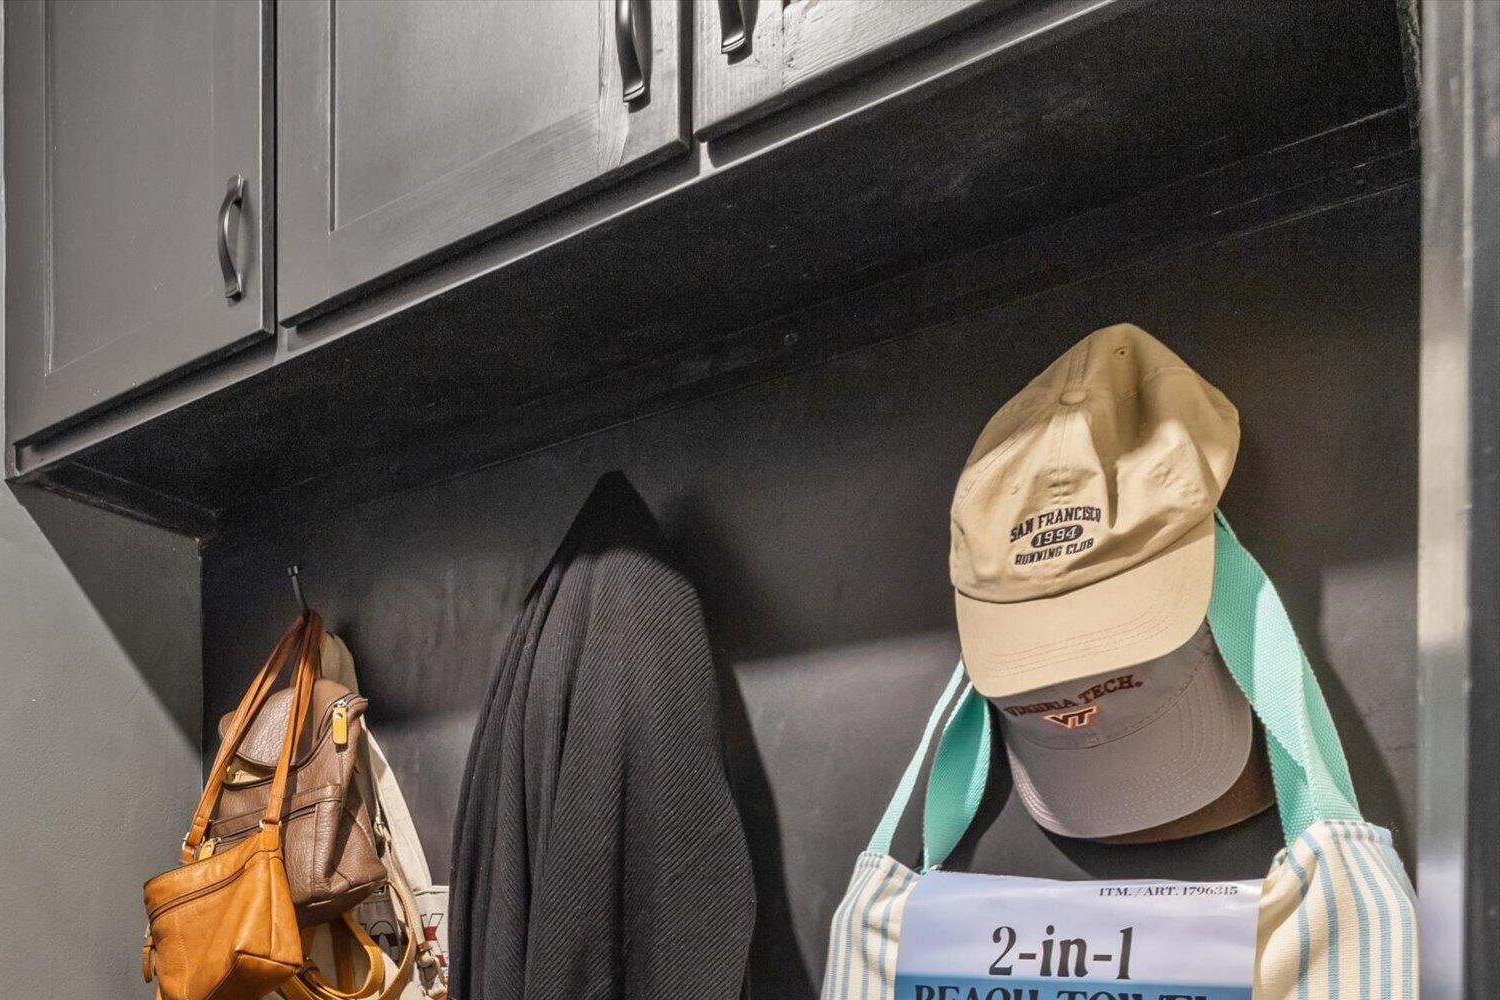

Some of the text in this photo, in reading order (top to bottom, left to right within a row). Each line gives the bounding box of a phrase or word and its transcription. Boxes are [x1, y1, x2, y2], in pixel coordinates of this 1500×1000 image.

[1010, 506, 1101, 543] SAN FRANCISCO
[1035, 526, 1078, 547] 1994
[1015, 538, 1094, 565] RUNNING CLUB
[1003, 699, 1078, 717] VIRGINIA
[1043, 706, 1101, 729] VT
[1182, 886, 1238, 896] 1796315
[989, 925, 1133, 980] 2-in-1
